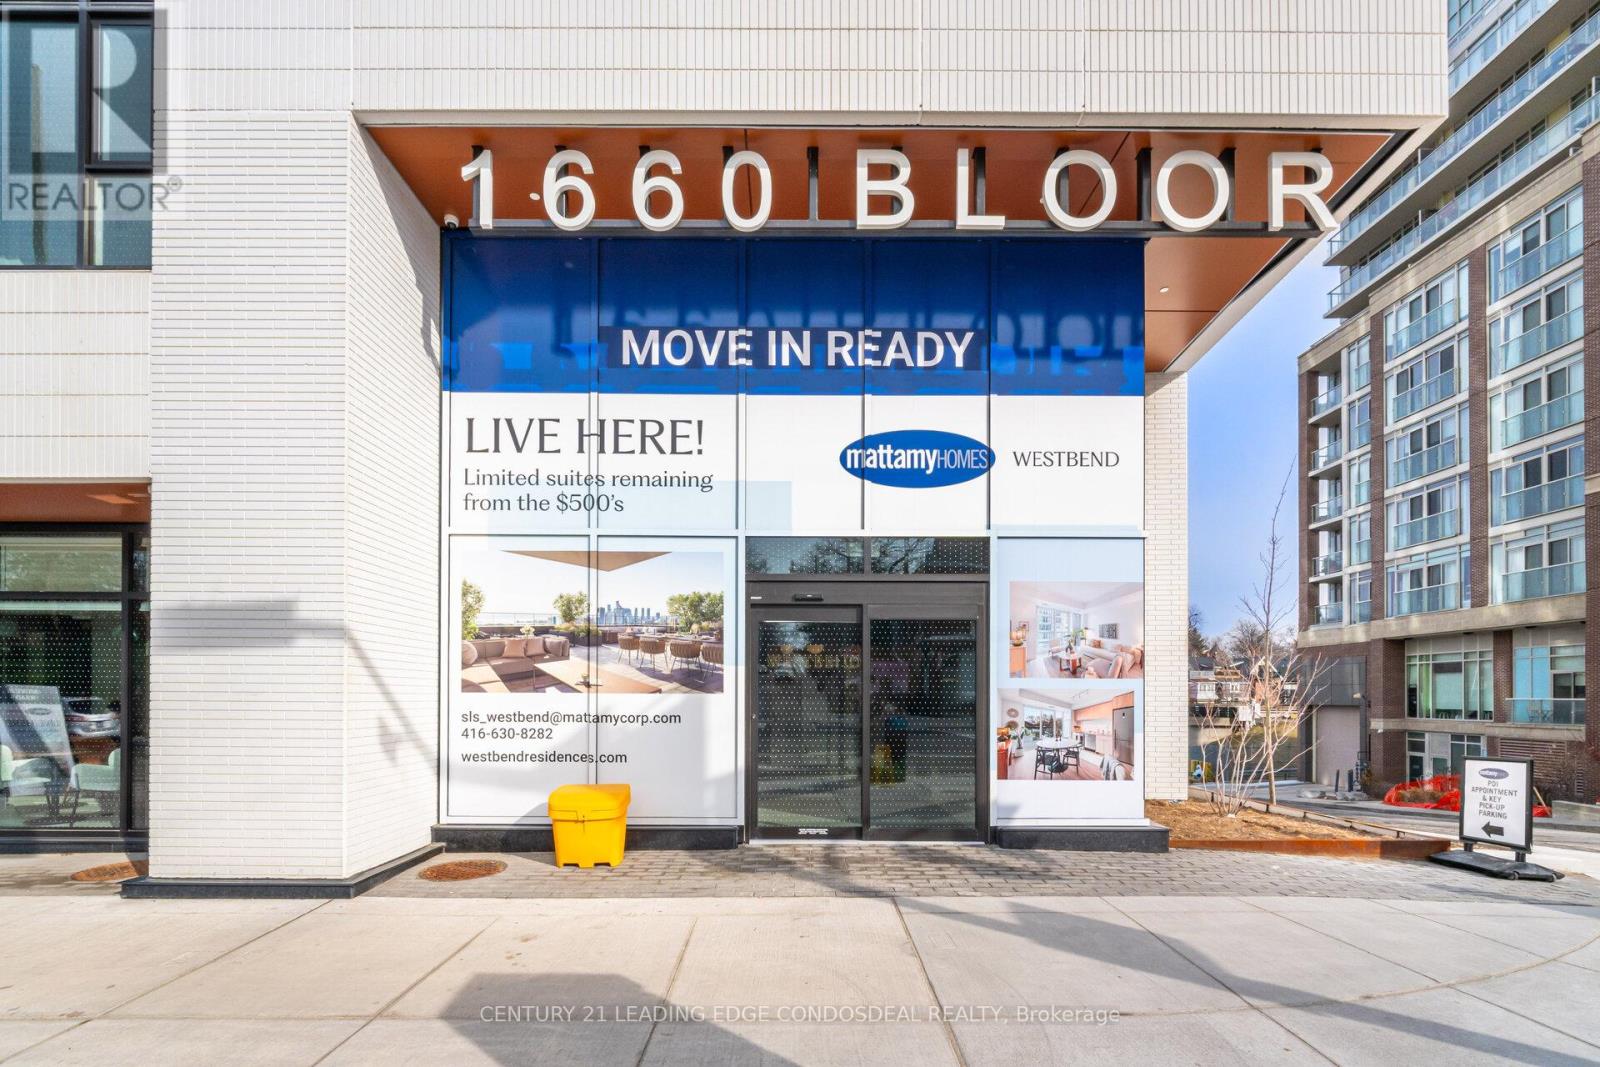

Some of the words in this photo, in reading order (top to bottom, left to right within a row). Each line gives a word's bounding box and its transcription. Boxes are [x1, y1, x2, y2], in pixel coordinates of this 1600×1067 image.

[460, 149, 774, 233] 1660
[855, 148, 1338, 233] BLOOR
[621, 328, 753, 367] MOVE
[767, 329, 811, 367] IN
[826, 329, 975, 369] READY
[466, 417, 562, 454] LIVE
[576, 418, 704, 456] HERE!
[1012, 450, 1121, 468] WESTBEND
[464, 468, 540, 487] Limited
[546, 470, 606, 488] suites
[611, 470, 714, 494] remaining
[464, 493, 511, 512] from
[518, 493, 551, 512] the
[461, 710, 682, 727] sls_westbend@mattamycorp.com
[461, 727, 554, 740] 416-630-8282
[461, 750, 628, 764] westbendresidences.com
[1471, 786, 1518, 796] APPOINTMENT
[1479, 802, 1506, 811] PICK-UP
[1479, 810, 1507, 819] PARKING
